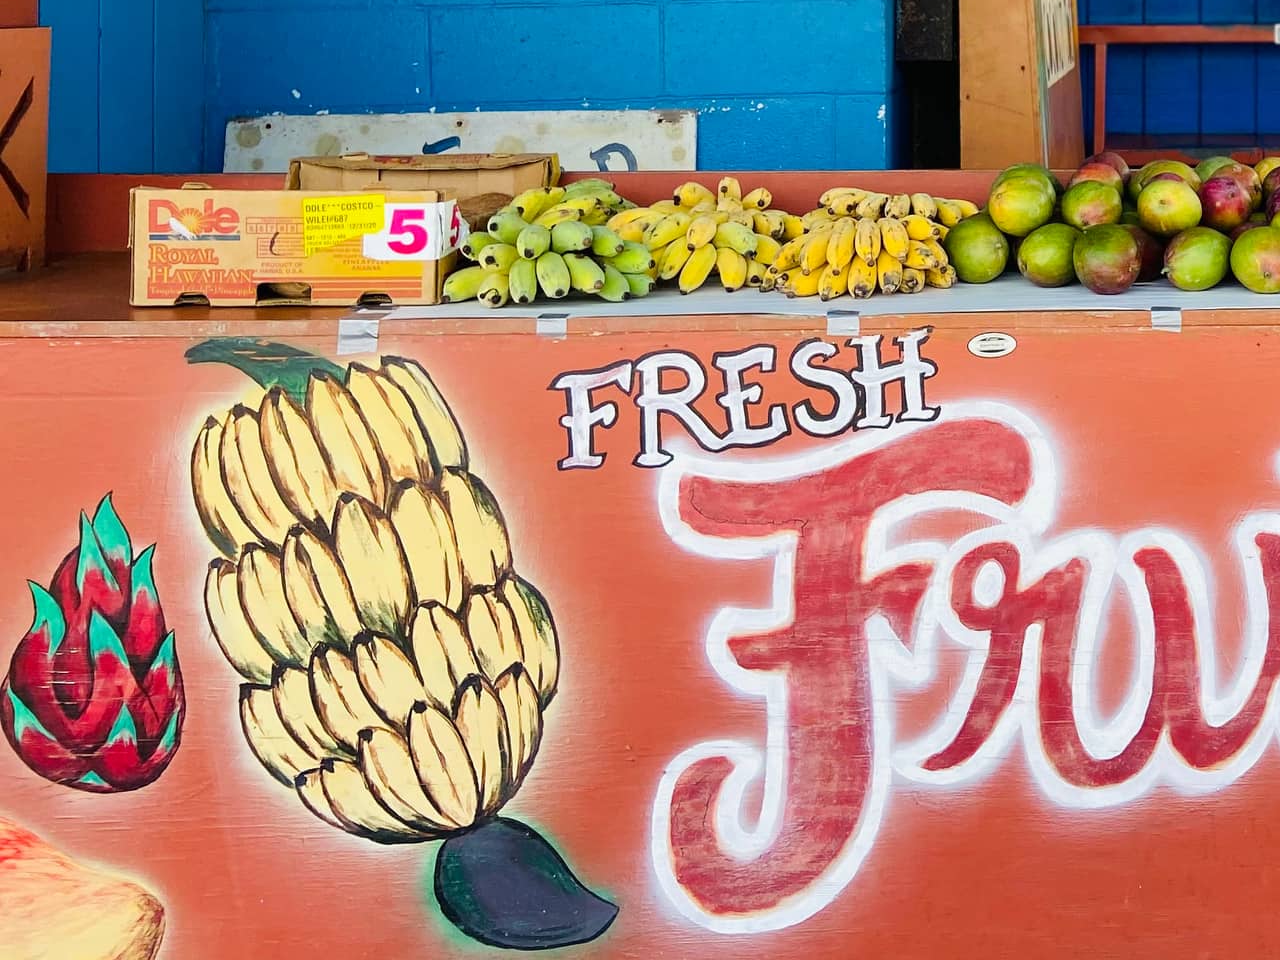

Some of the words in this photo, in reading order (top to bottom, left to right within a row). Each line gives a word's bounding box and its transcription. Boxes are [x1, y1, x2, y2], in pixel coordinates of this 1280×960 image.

[148, 198, 241, 234] Dole
[386, 209, 429, 256] 5
[149, 243, 220, 265] ROYAL
[149, 264, 257, 284] HAWAIIAN
[547, 325, 942, 470] FRESH
